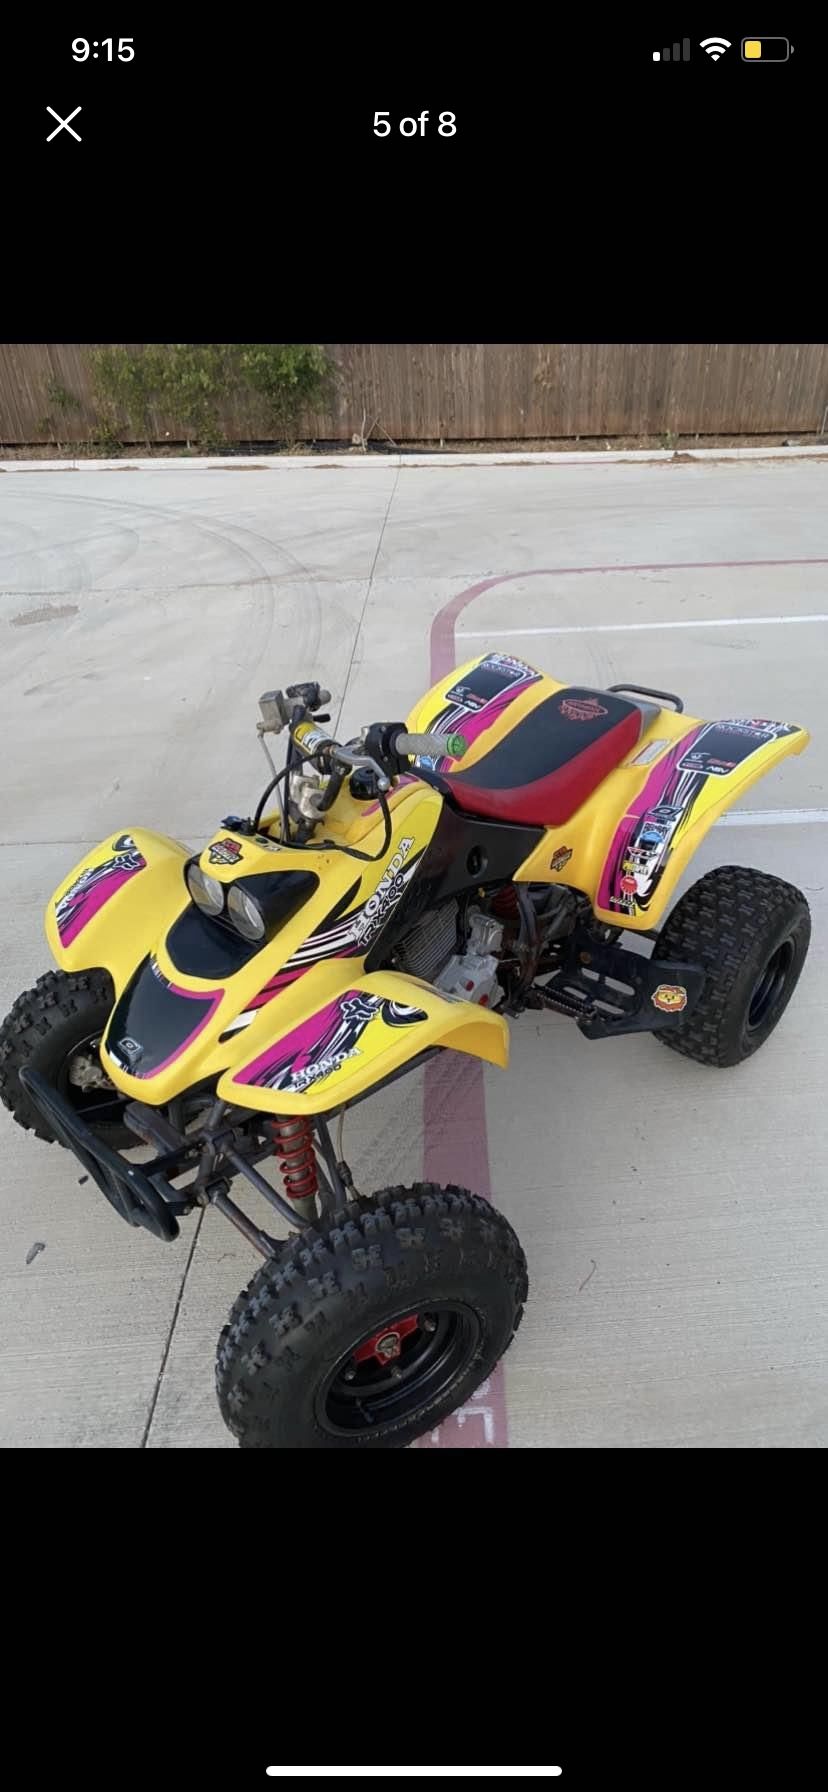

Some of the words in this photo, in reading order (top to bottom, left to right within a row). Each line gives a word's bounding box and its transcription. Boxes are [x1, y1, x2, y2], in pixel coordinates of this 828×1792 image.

[347, 837, 415, 941] HONDA
[357, 872, 404, 946] TRX400
[290, 1047, 363, 1082] HONDA
